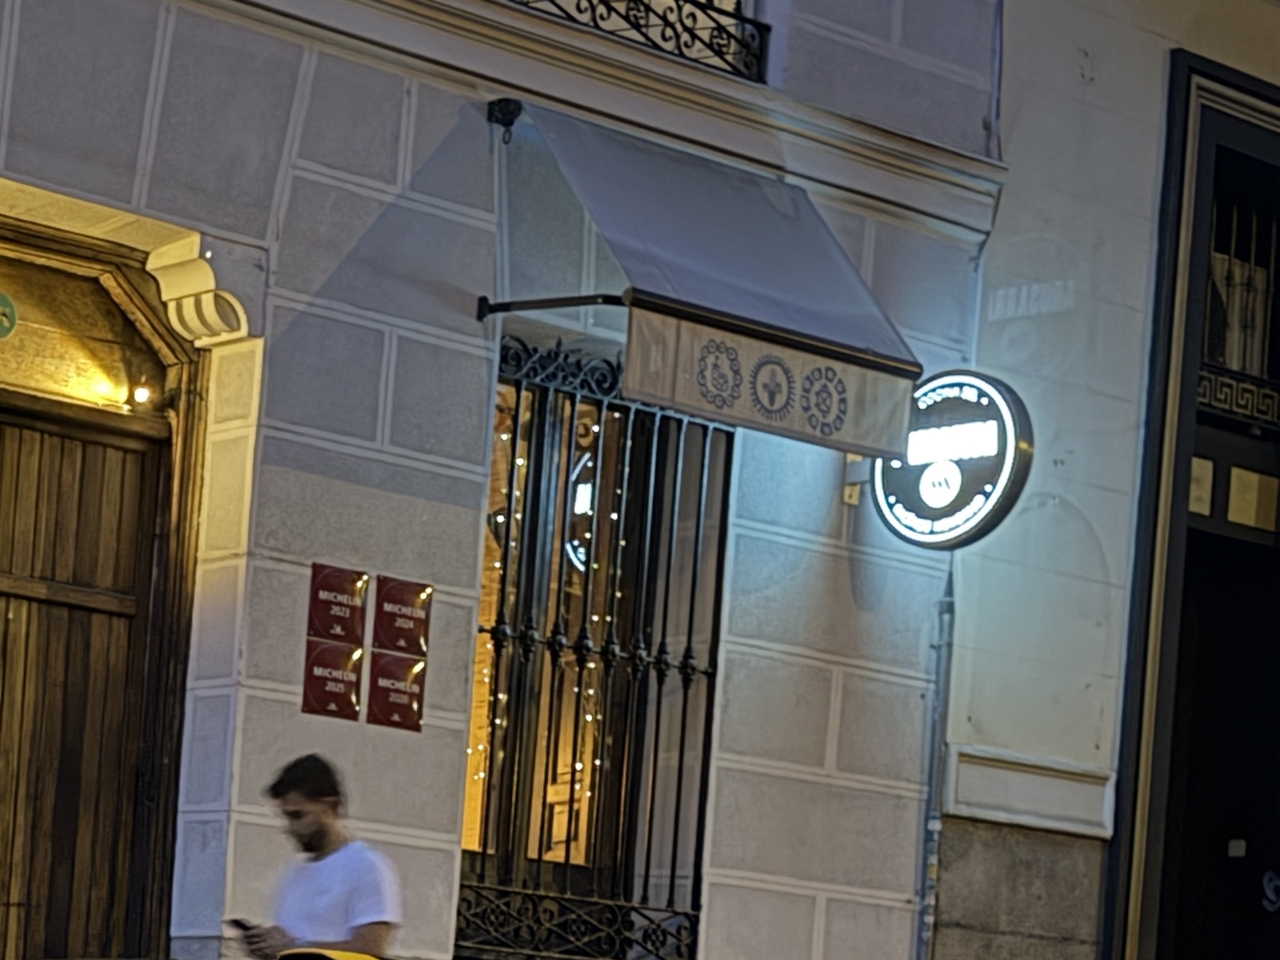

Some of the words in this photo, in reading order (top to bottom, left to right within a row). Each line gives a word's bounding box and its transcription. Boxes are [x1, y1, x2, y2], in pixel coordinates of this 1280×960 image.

[318, 590, 362, 607] MICHELIN
[330, 605, 350, 618] 2023
[383, 602, 426, 620] MICHELIN
[394, 617, 414, 629] 2024
[313, 666, 357, 683] MICHELIN
[378, 677, 420, 694] MICHELIN
